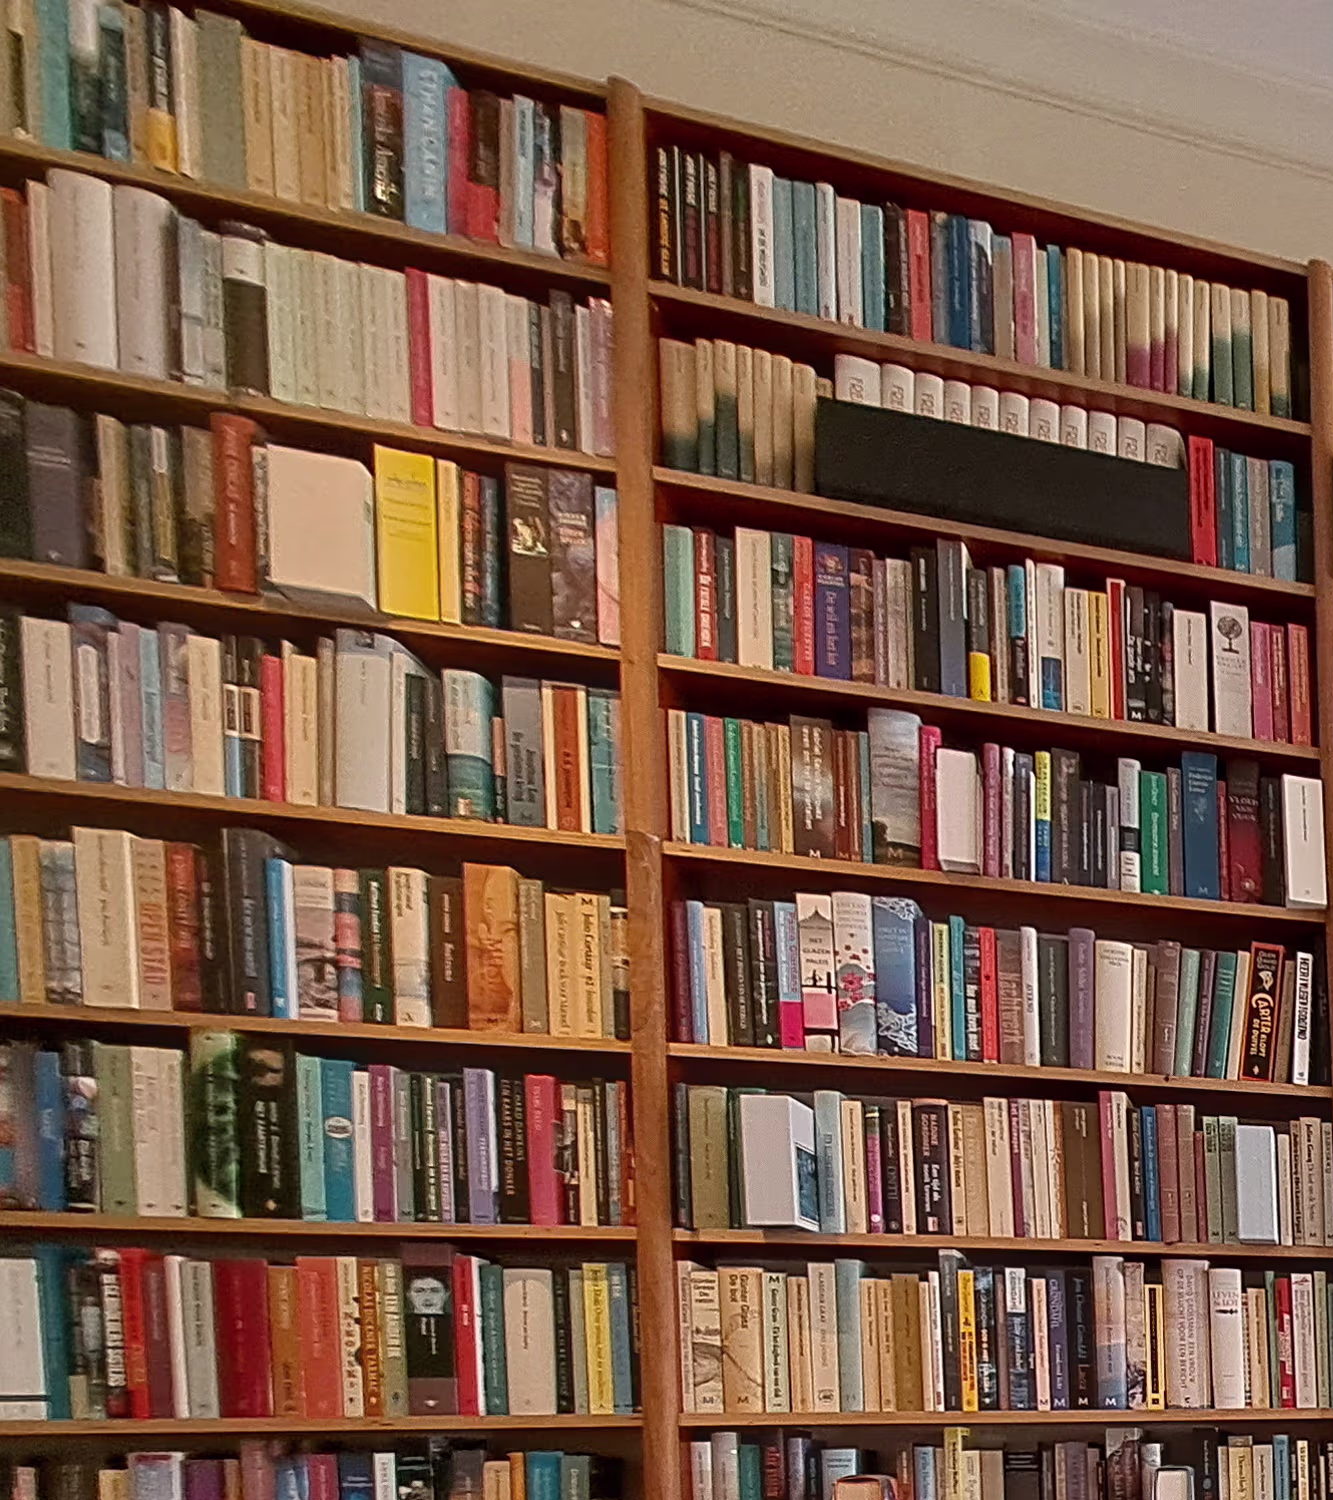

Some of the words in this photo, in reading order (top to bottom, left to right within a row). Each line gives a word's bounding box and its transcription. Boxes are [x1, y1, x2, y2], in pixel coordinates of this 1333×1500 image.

[140, 903, 168, 942] OPEN
[142, 950, 168, 986] STAD
[999, 973, 1023, 1044] Nachtwerk
[1251, 993, 1274, 1033] CARTER
